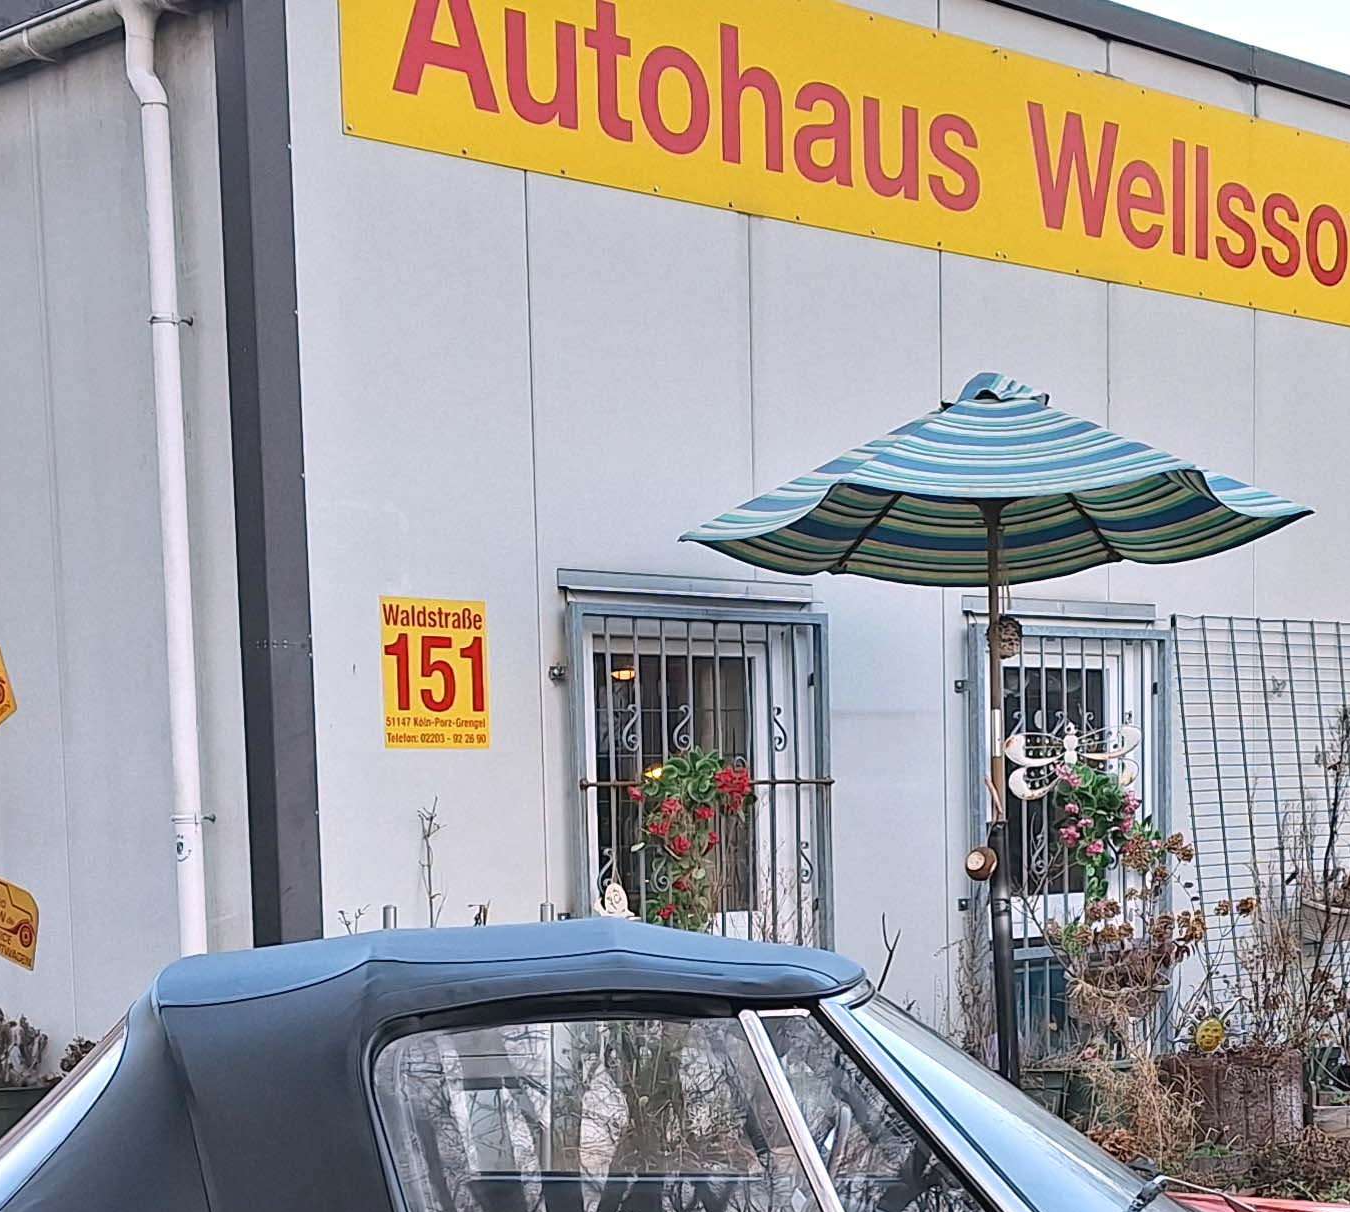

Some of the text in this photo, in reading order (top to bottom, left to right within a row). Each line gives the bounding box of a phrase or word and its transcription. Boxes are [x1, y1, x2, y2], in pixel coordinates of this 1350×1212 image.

[392, 0, 981, 212] Autohaus
[382, 604, 482, 630] Waldstraße
[384, 633, 485, 713] 151
[386, 716, 411, 727] 51147
